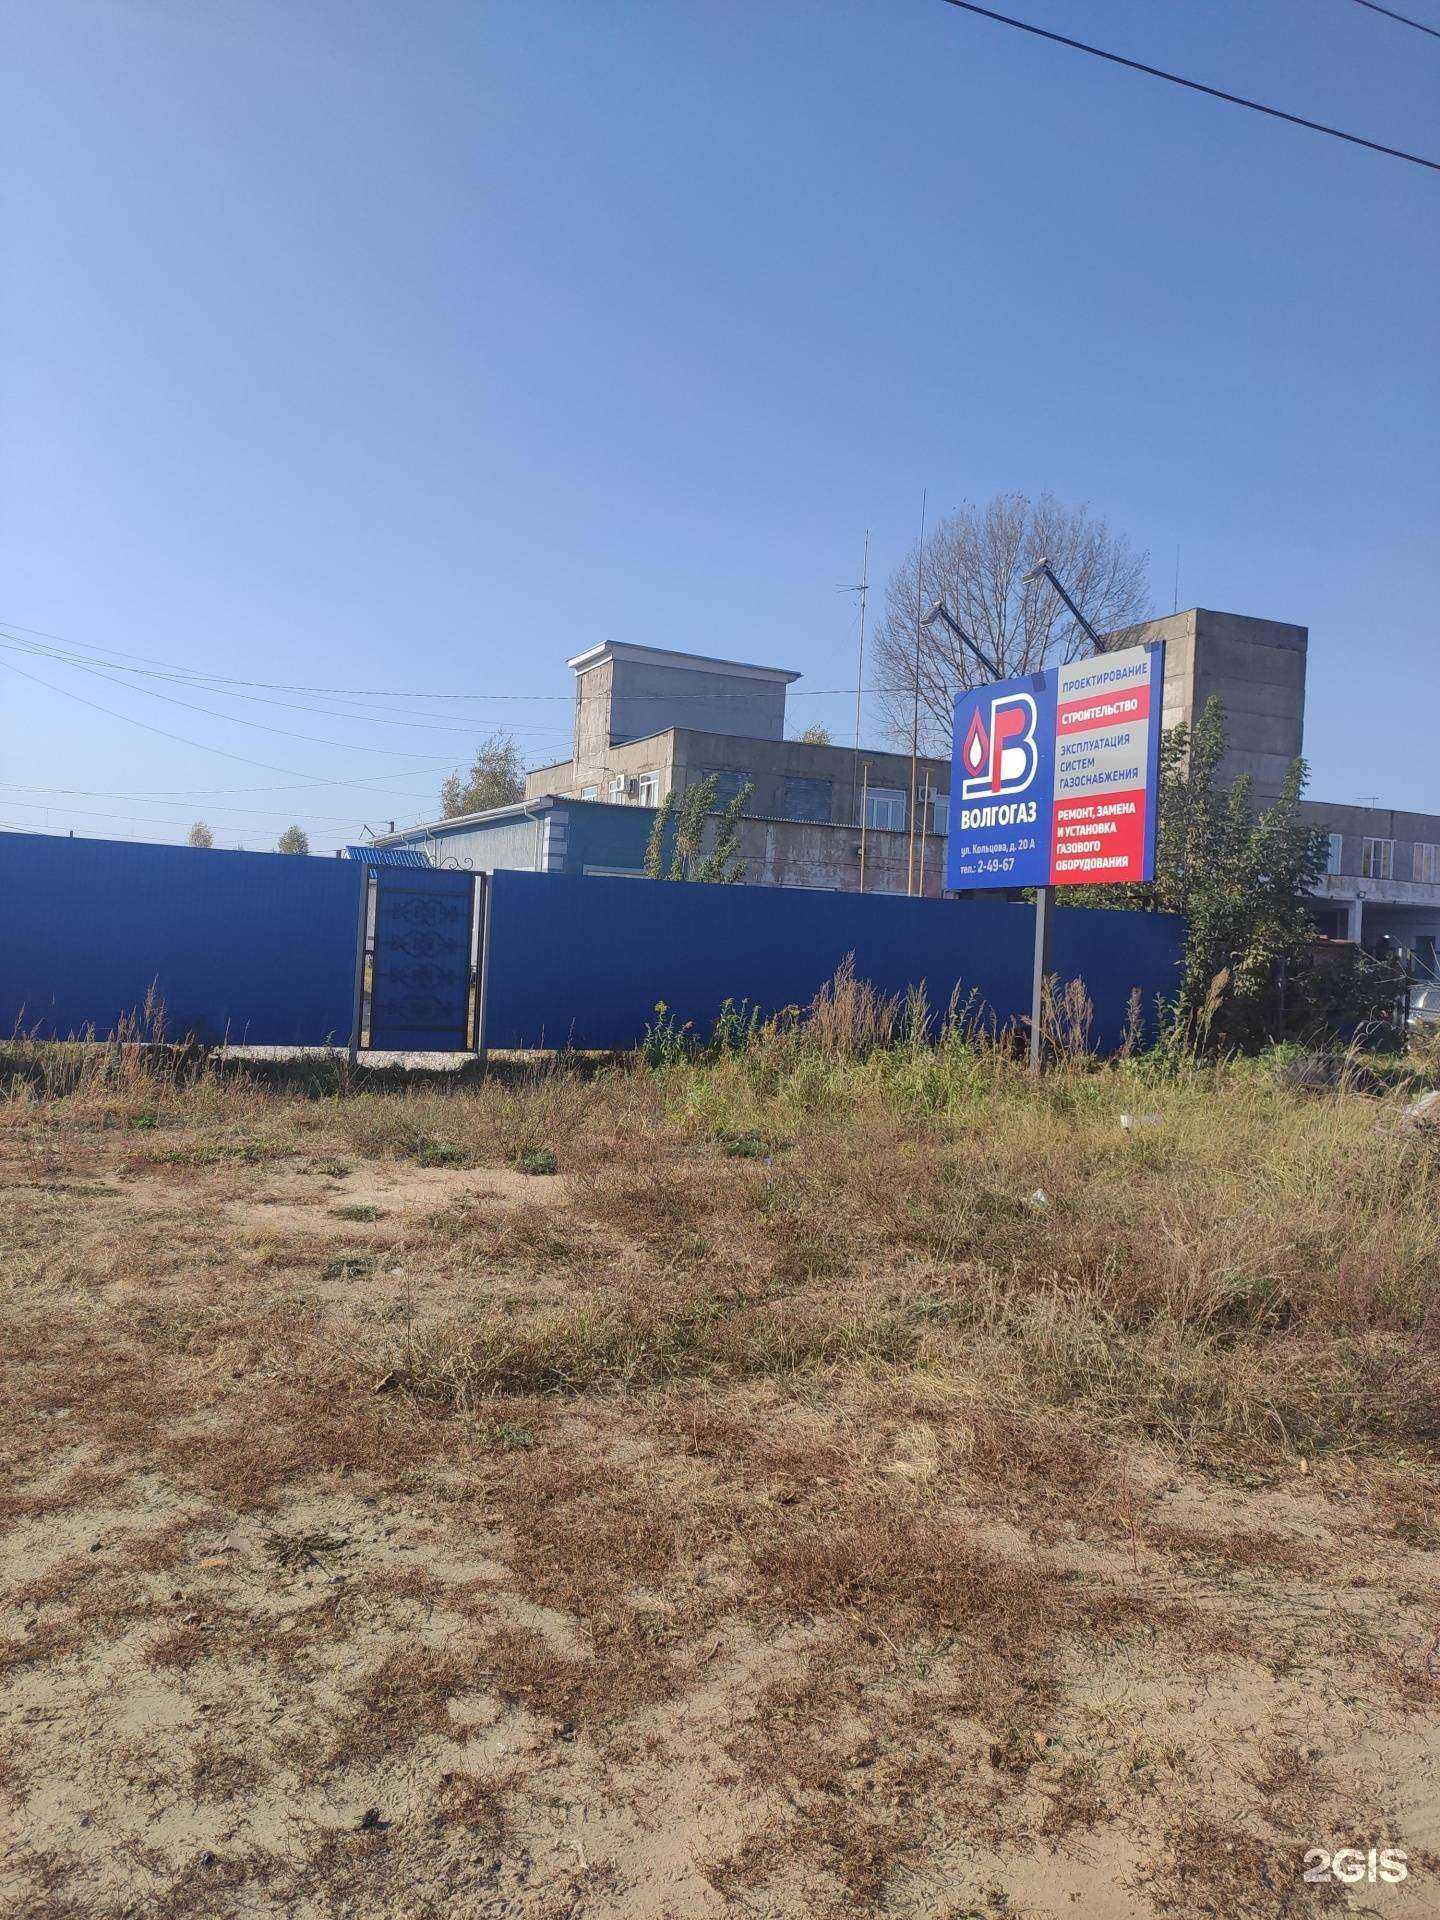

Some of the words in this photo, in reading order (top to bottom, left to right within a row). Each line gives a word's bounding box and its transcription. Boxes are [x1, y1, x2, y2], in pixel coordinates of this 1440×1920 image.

[1062, 663, 1147, 693] ПРОЕКТИРОВАНИЕ
[1062, 699, 1138, 725] СТРОИТЕЛЬСТВО
[1061, 733, 1130, 756] ЭКСПЛУАТАЦИЯ
[1060, 758, 1095, 772] СИСТЕМ
[1059, 768, 1138, 789] ГАЗОСНАБЖЕНИЯ
[961, 802, 1036, 829] ВОЛГОГАЗ
[1058, 806, 1095, 820] РЕМОНТ,
[1097, 803, 1135, 816] ЗАМЕНА
[1057, 827, 1064, 838] И
[1065, 822, 1116, 837] УСТАНОВКА
[961, 845, 971, 857] ул.
[1009, 842, 1017, 852] д.
[1057, 840, 1100, 854] ГАЗОВОГО
[978, 858, 1014, 872] 2-49-67
[1056, 857, 1128, 871] ОБОРУДОВАНИЯ
